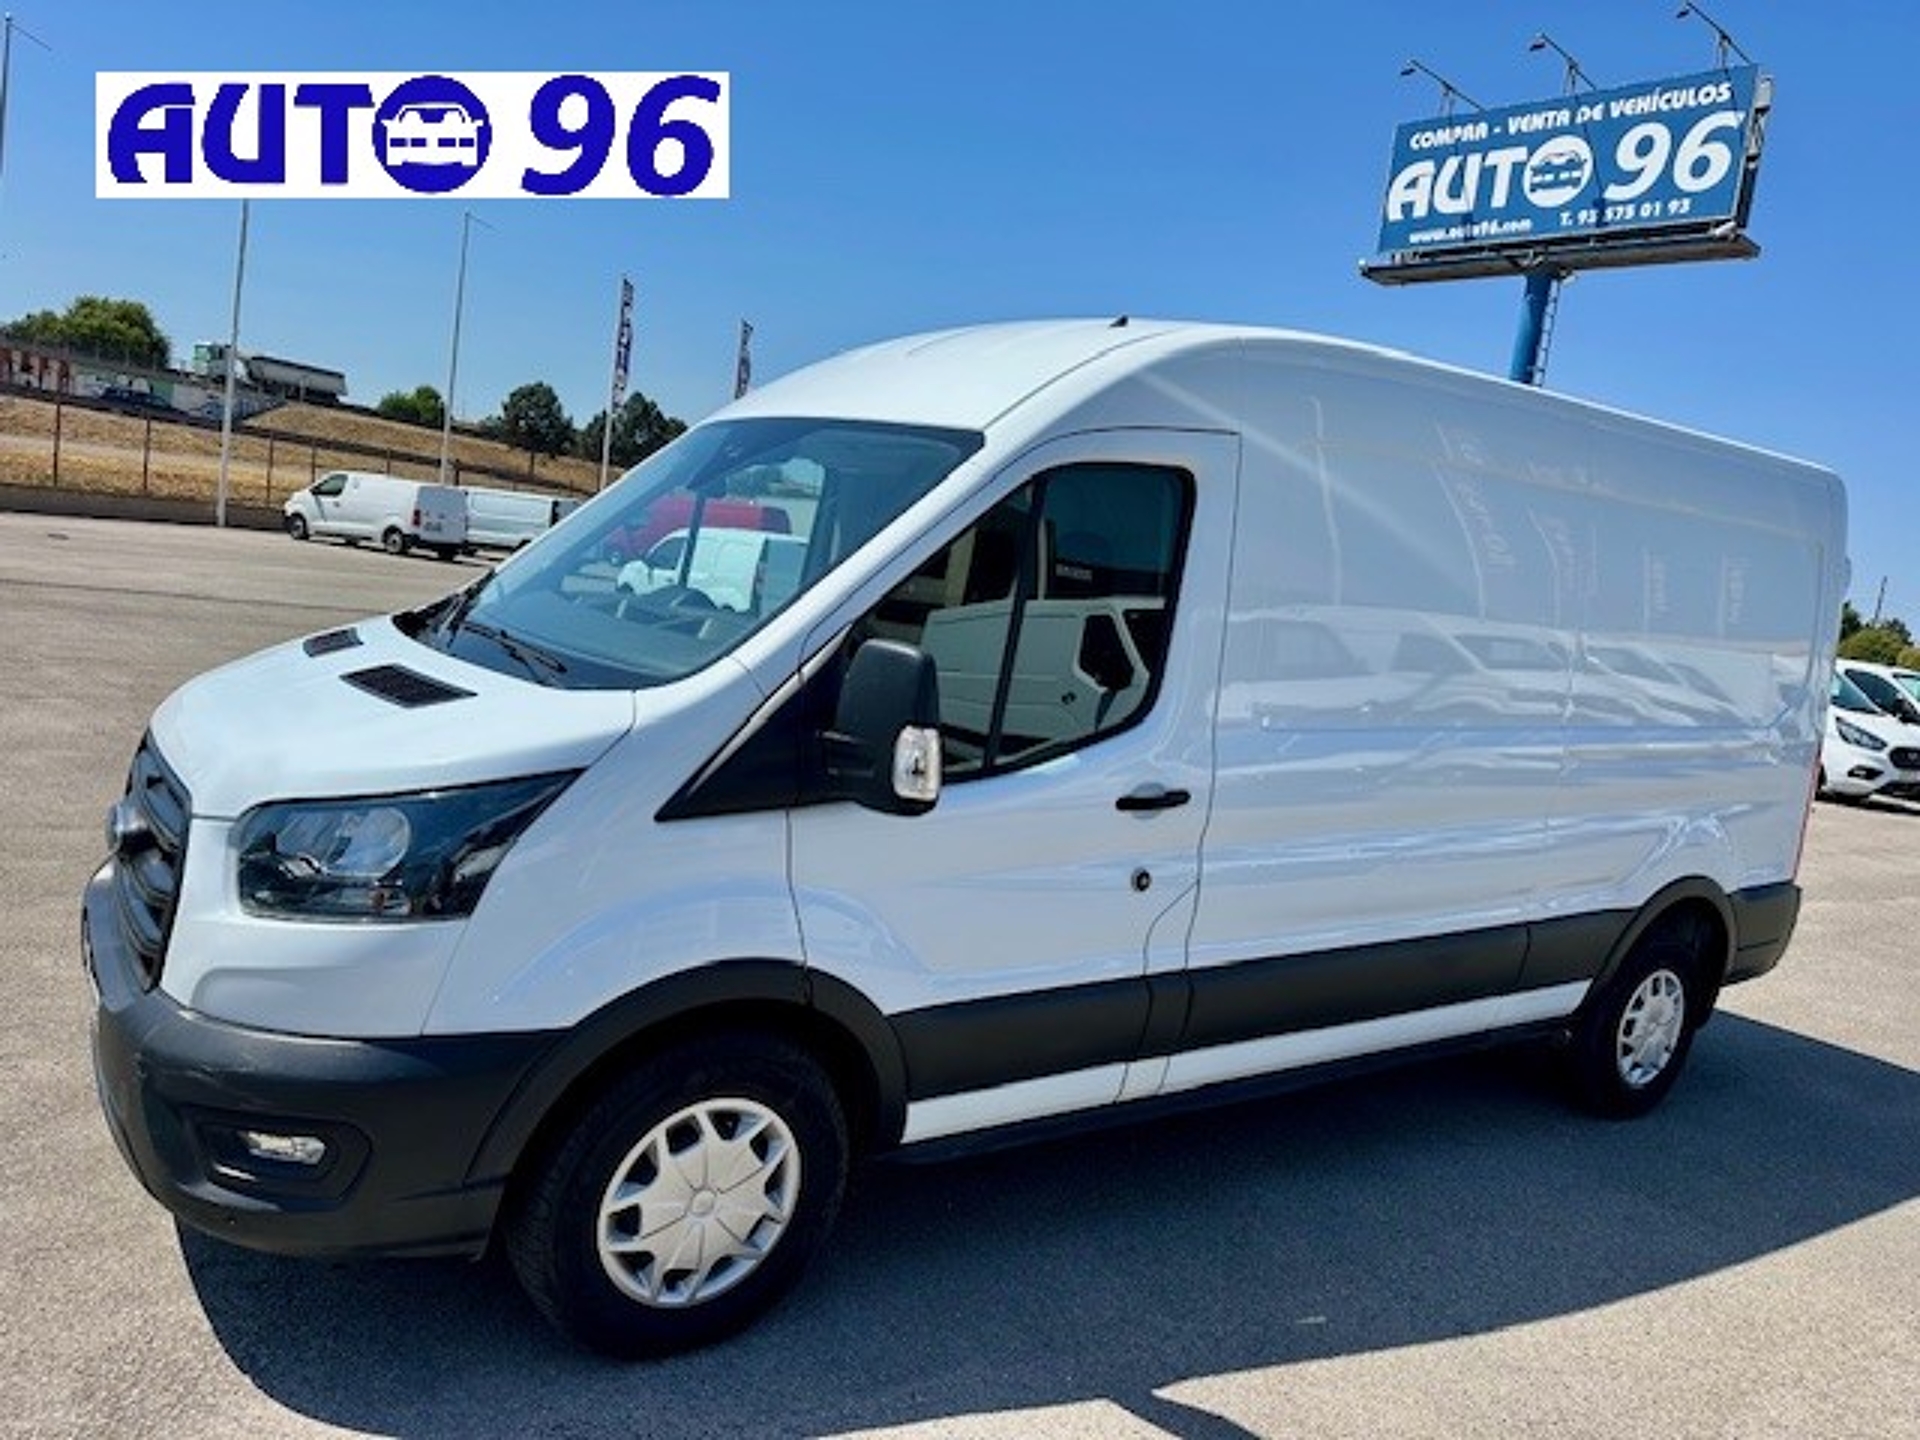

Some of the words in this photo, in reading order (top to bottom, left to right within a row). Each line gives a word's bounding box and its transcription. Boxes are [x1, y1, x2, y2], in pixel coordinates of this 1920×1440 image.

[1508, 108, 1571, 135] VENTA
[1575, 103, 1604, 124] DE
[1610, 82, 1732, 118] VEHÍCULOS
[1387, 135, 1593, 222] AUTO
[1602, 110, 1745, 201] 96
